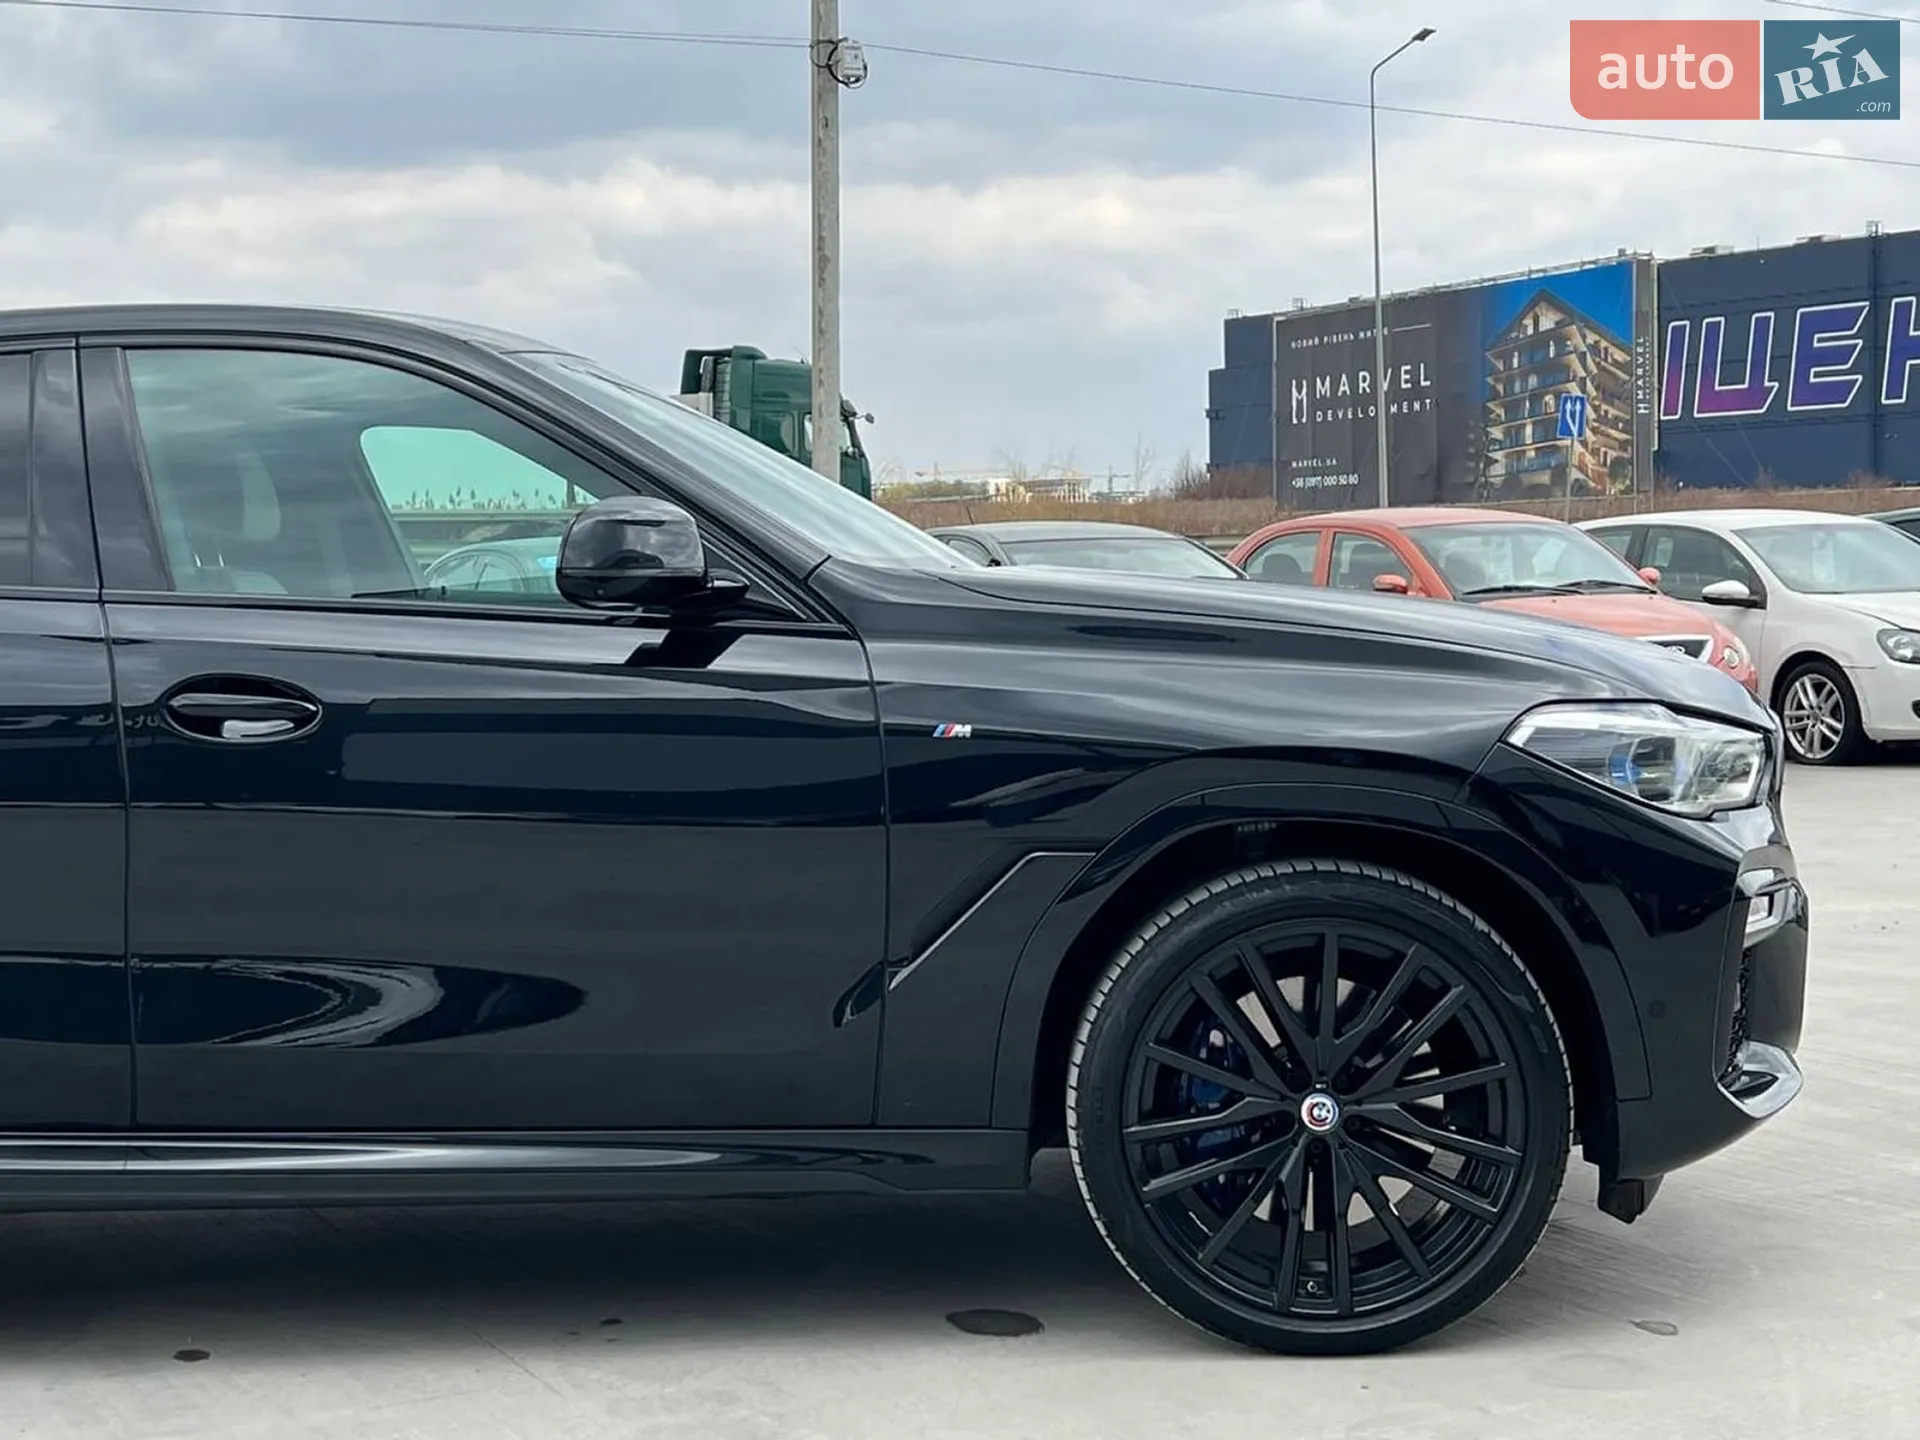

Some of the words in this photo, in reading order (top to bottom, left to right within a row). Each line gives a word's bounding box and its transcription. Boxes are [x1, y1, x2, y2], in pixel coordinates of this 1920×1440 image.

[1315, 363, 1432, 400] MARVEL
[1315, 398, 1432, 423] DEVELOMENT
[1323, 475, 1338, 487] 000
